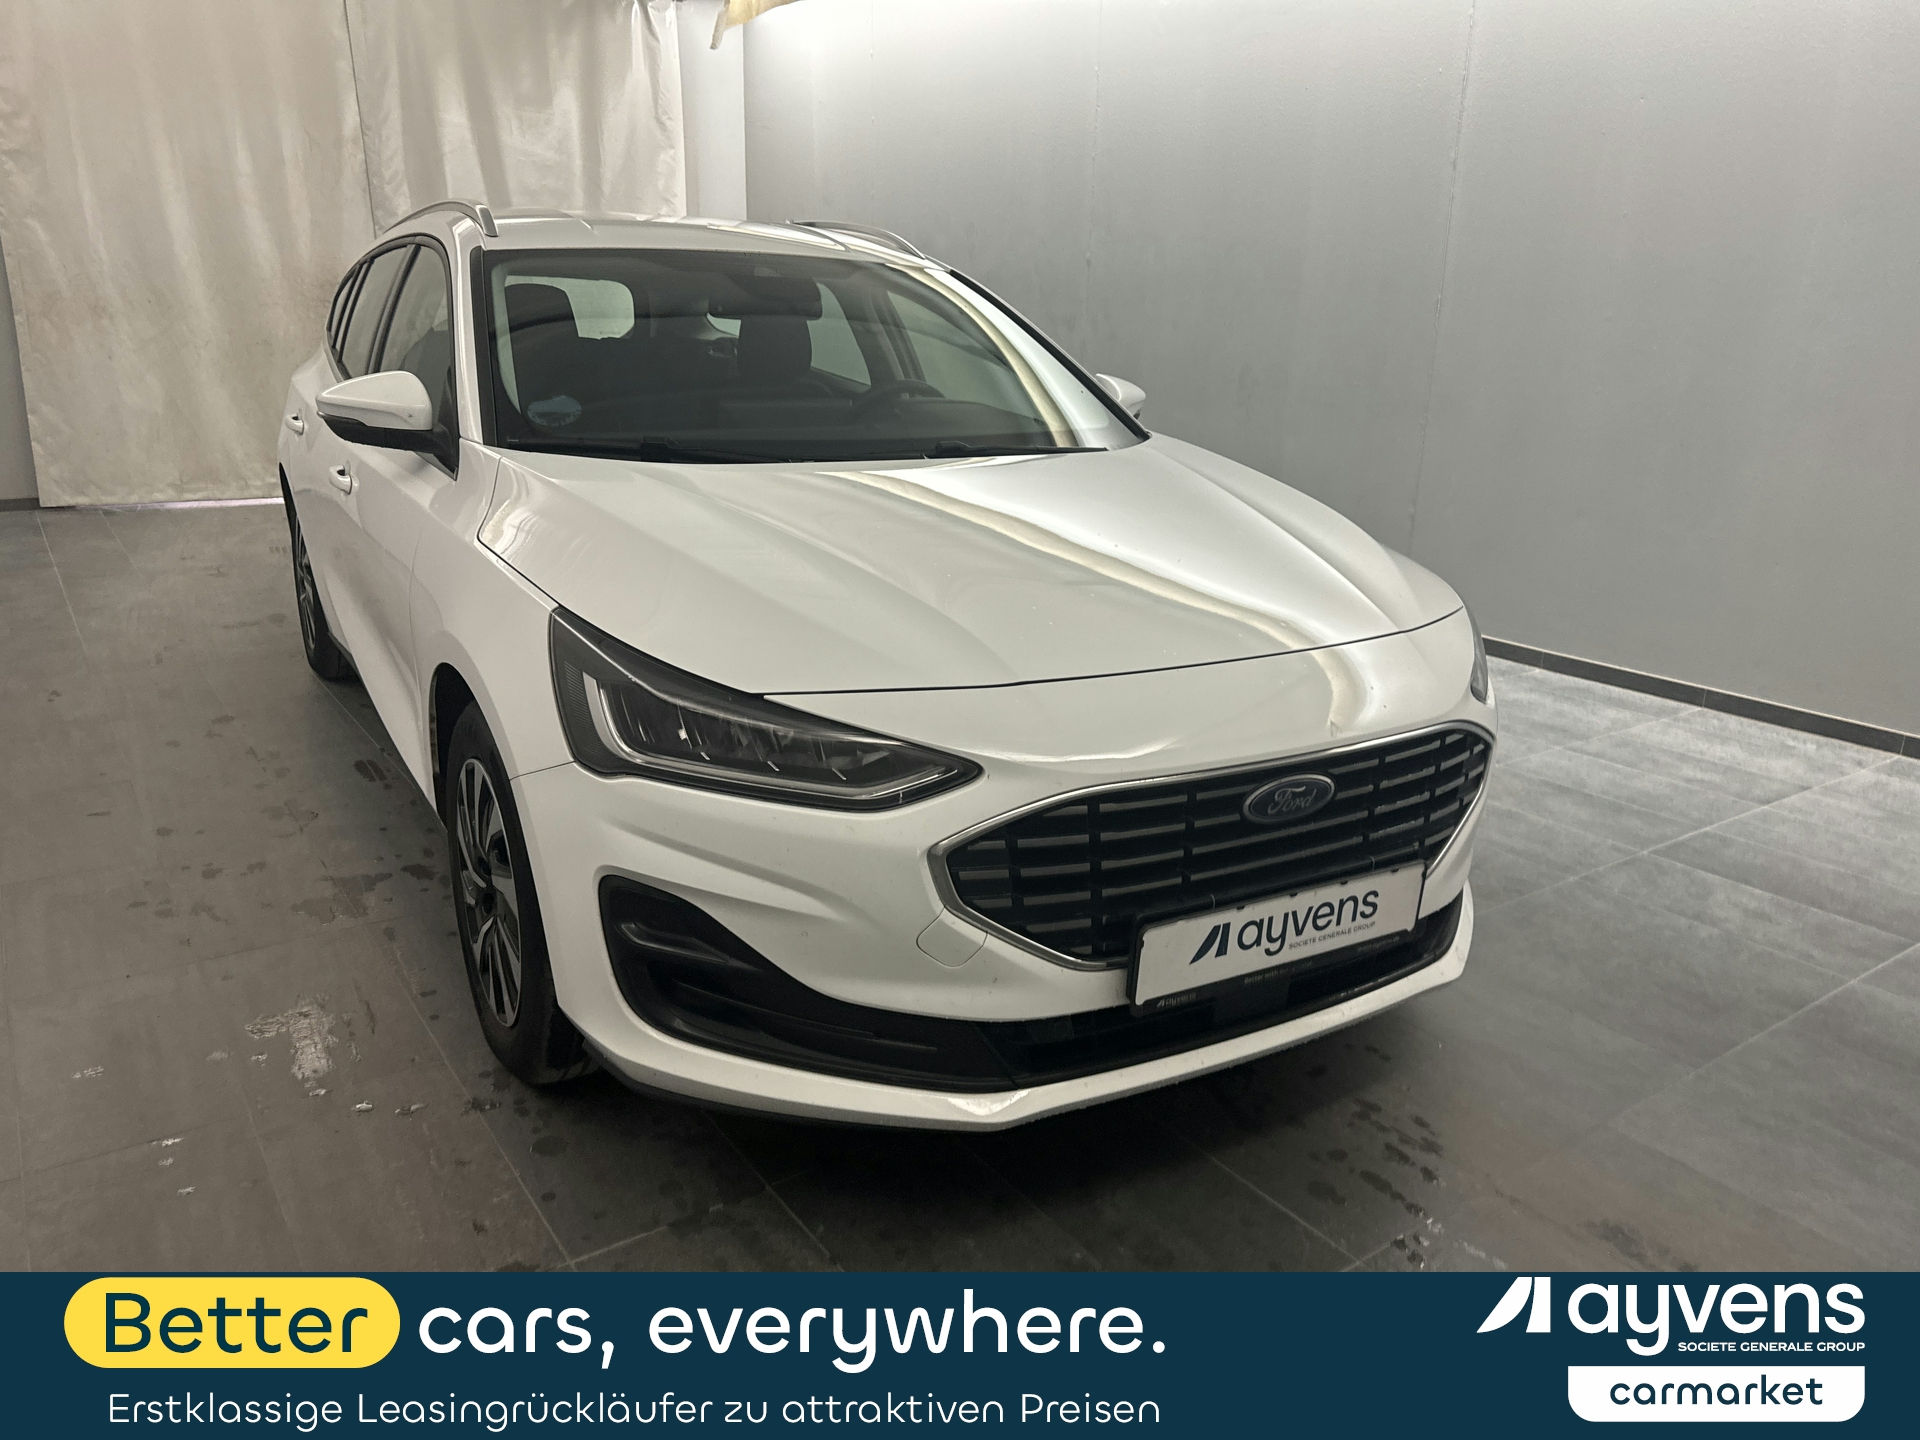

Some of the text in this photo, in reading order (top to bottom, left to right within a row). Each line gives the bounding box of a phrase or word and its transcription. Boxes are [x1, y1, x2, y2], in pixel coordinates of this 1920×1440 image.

[1268, 786, 1317, 814] Ford
[1237, 890, 1379, 956] ayvens
[1289, 921, 1376, 950] SOCIETE GENERALE GROUP
